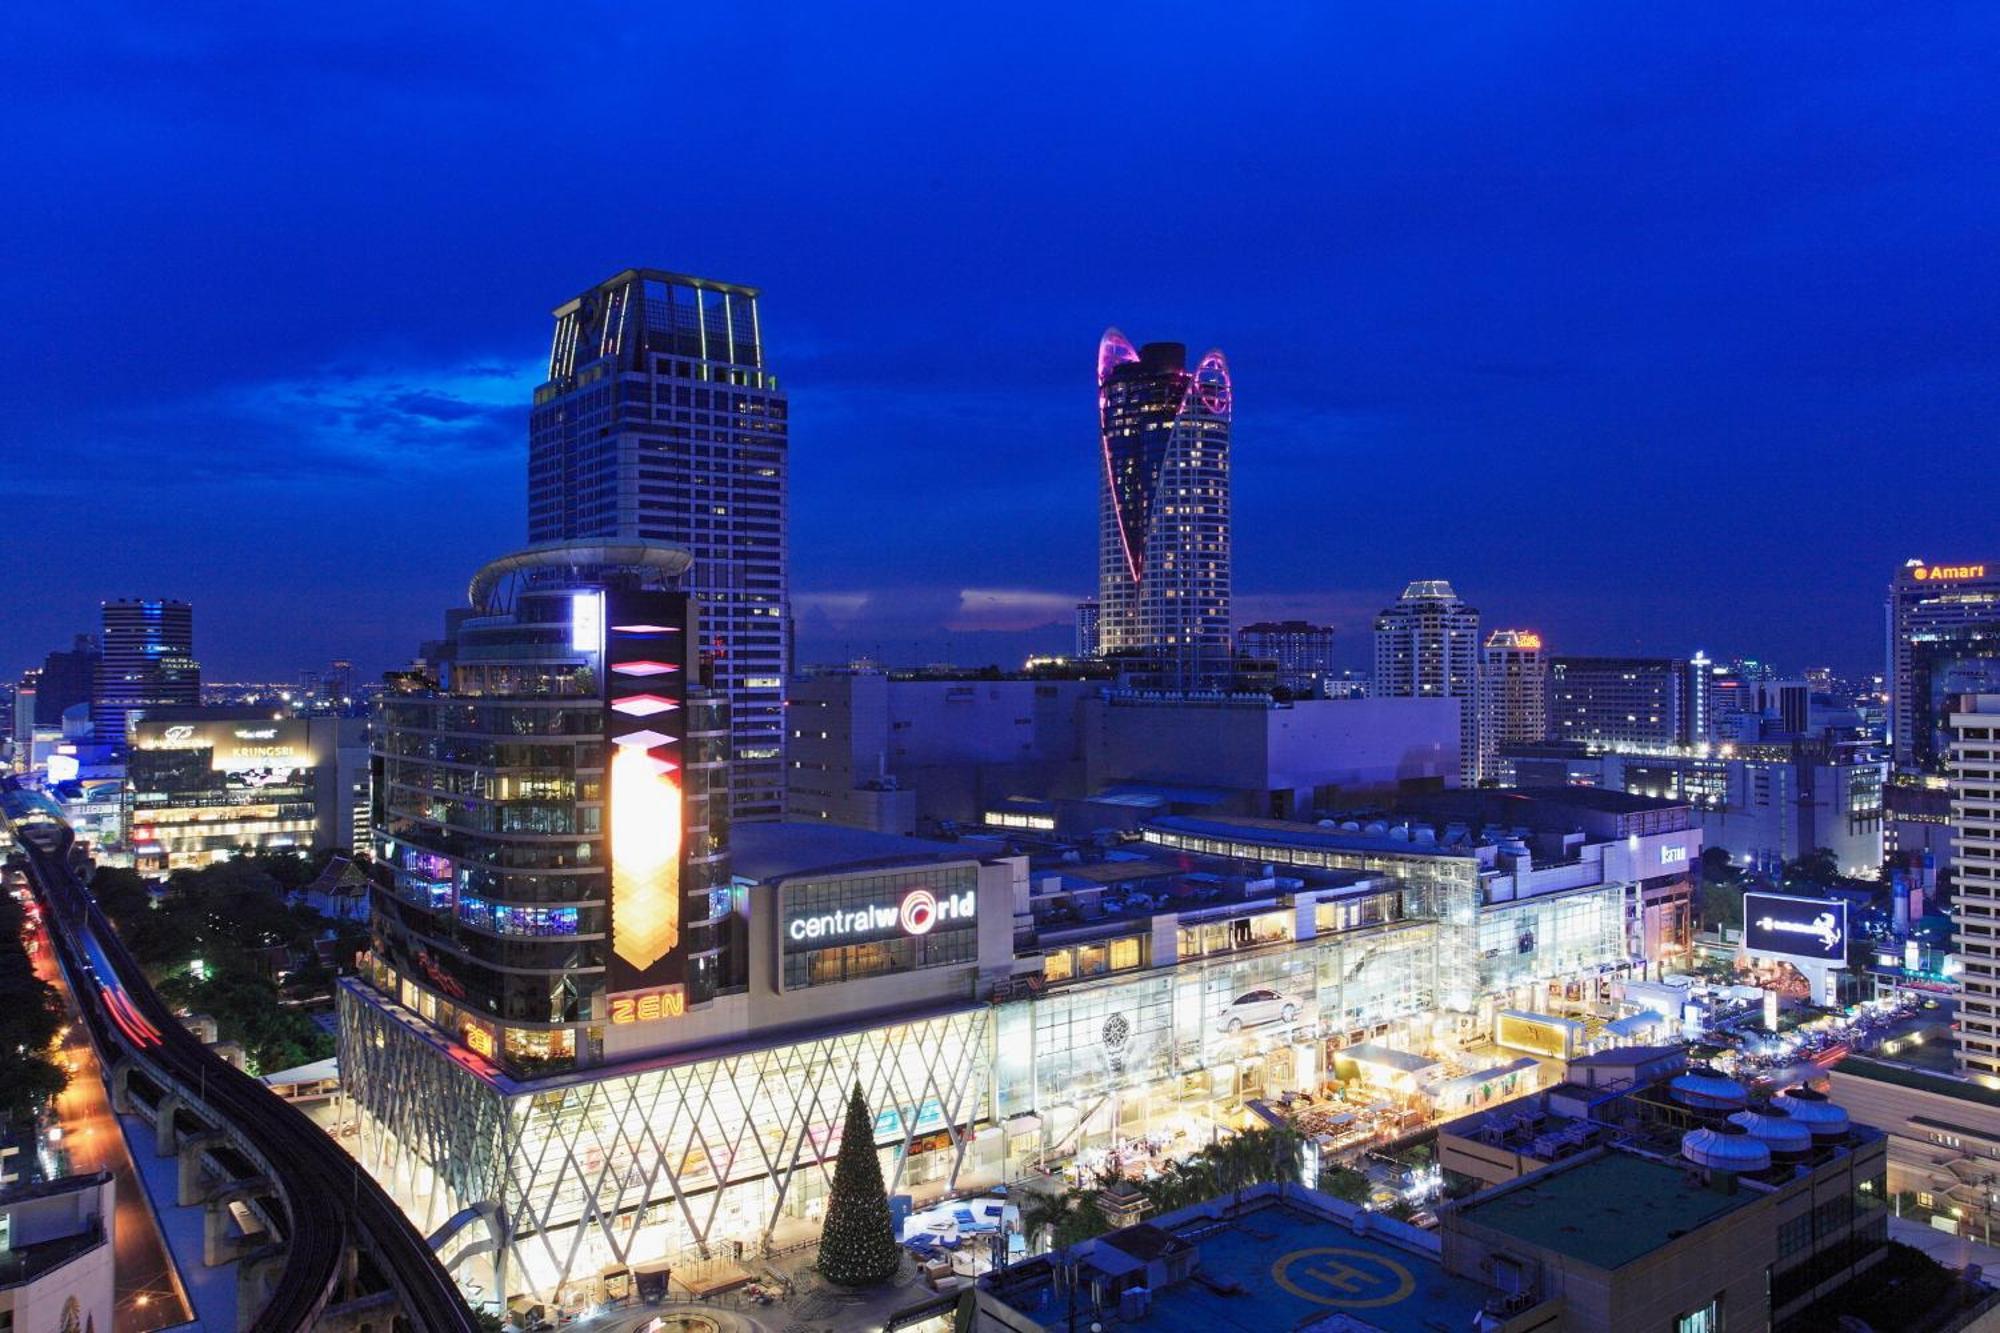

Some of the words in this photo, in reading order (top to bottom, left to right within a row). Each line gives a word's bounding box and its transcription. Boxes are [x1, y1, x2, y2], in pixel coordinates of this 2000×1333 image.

[1930, 565, 1984, 579] Amari
[613, 992, 684, 1024] ZEN
[1304, 1260, 1385, 1293] H
